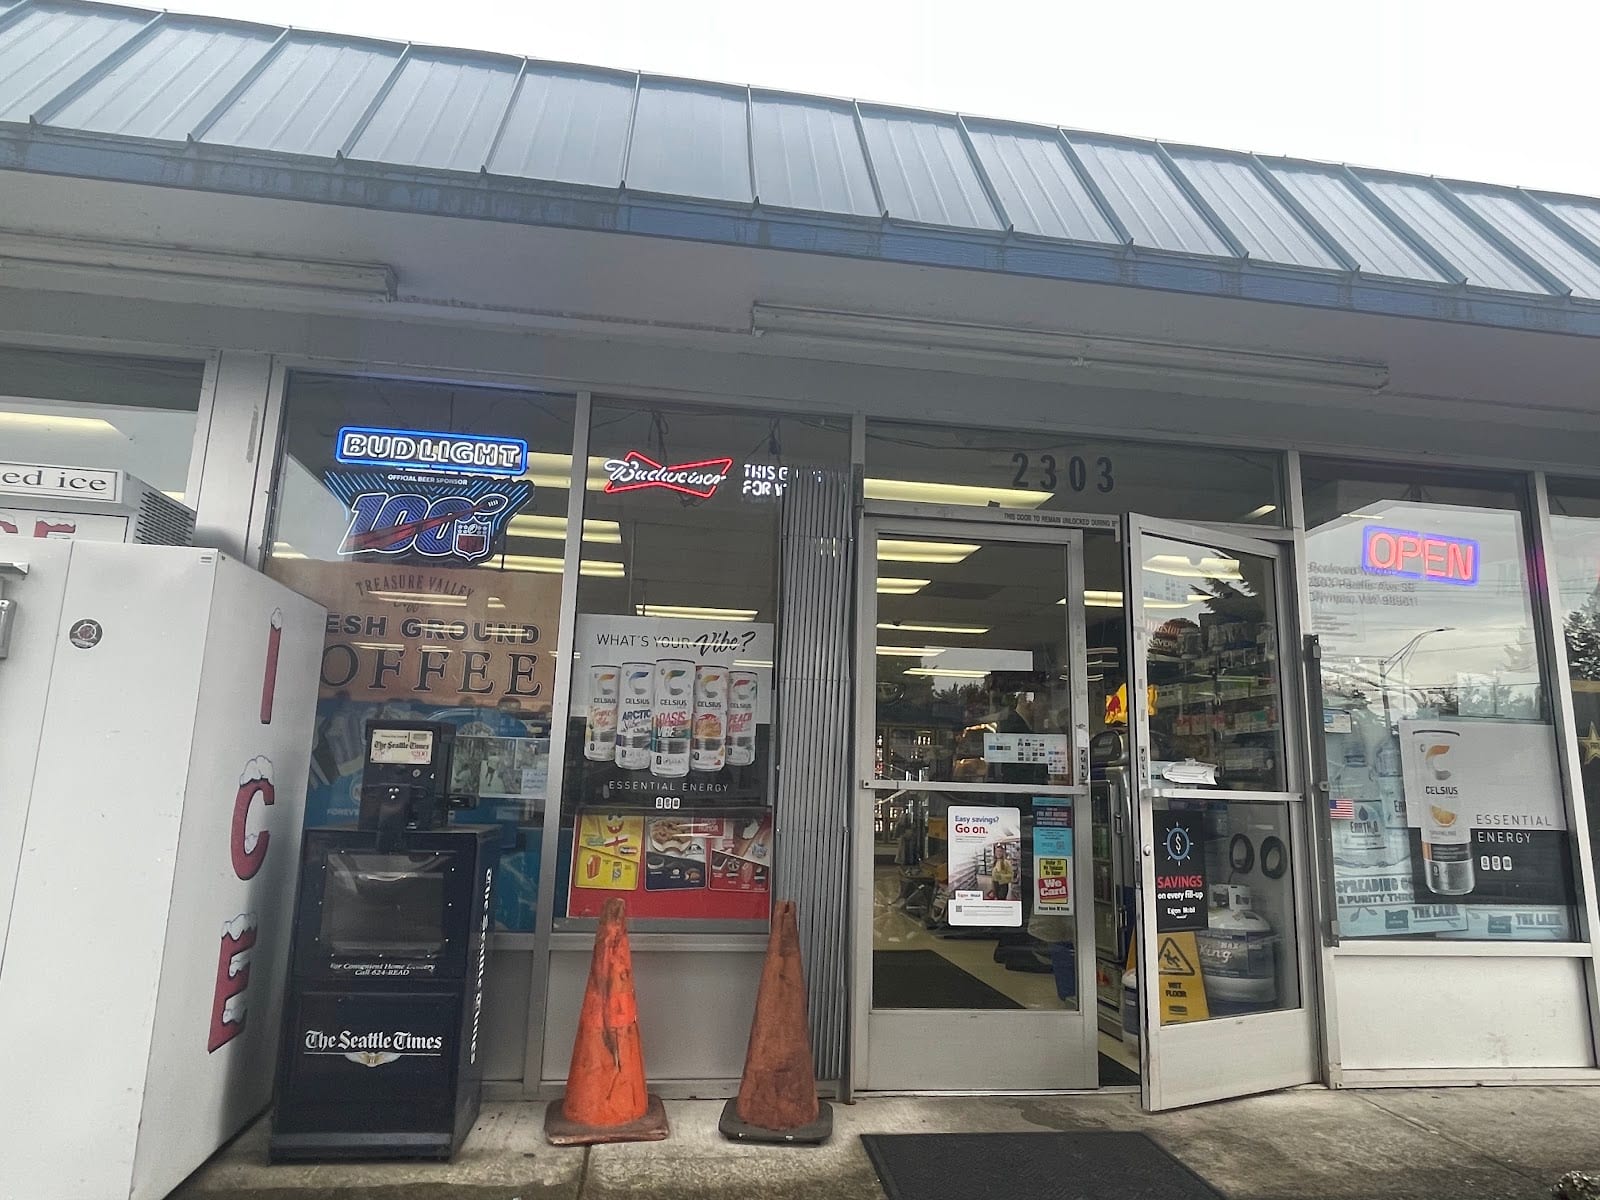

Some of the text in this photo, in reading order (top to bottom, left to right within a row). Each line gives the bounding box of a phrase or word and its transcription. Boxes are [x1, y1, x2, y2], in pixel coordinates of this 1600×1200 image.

[342, 433, 520, 467] BUD LIGHT
[604, 459, 727, 485] Budweiser
[743, 463, 775, 480] THIS
[1012, 452, 1114, 493] 2303
[56, 472, 107, 491] ice
[387, 474, 468, 486] OFFICIAL BEER SPONSOR
[742, 480, 771, 496] FOR
[1016, 513, 1032, 521] DOOR
[1368, 531, 1474, 581] OPEN
[355, 574, 475, 598] TREASURE VALLEY
[401, 618, 540, 644] GROUND
[596, 631, 757, 657] WHAT'S YOUR Vibe?
[625, 697, 650, 705] CELSIUS
[659, 698, 688, 706] CELSIUS
[697, 700, 722, 708] CELSIUS
[622, 709, 652, 721] ARCTIC
[609, 780, 729, 792] ESSENTIAL ENERGY
[1425, 786, 1459, 795] CELSIUS
[954, 815, 1000, 825] Easy savings?
[1475, 814, 1552, 827] ESSENTIAL
[955, 823, 988, 834] Go on.
[1477, 831, 1531, 844] ENERGY
[1043, 878, 1062, 888] We
[1156, 874, 1203, 889] SAVINGS
[1040, 886, 1067, 897] Card
[1166, 891, 1184, 901] every
[1184, 889, 1204, 901] fill-up
[1346, 894, 1388, 903] PURITY
[1165, 989, 1187, 998] FLOOR
[305, 1030, 443, 1052] The Seattle Times
